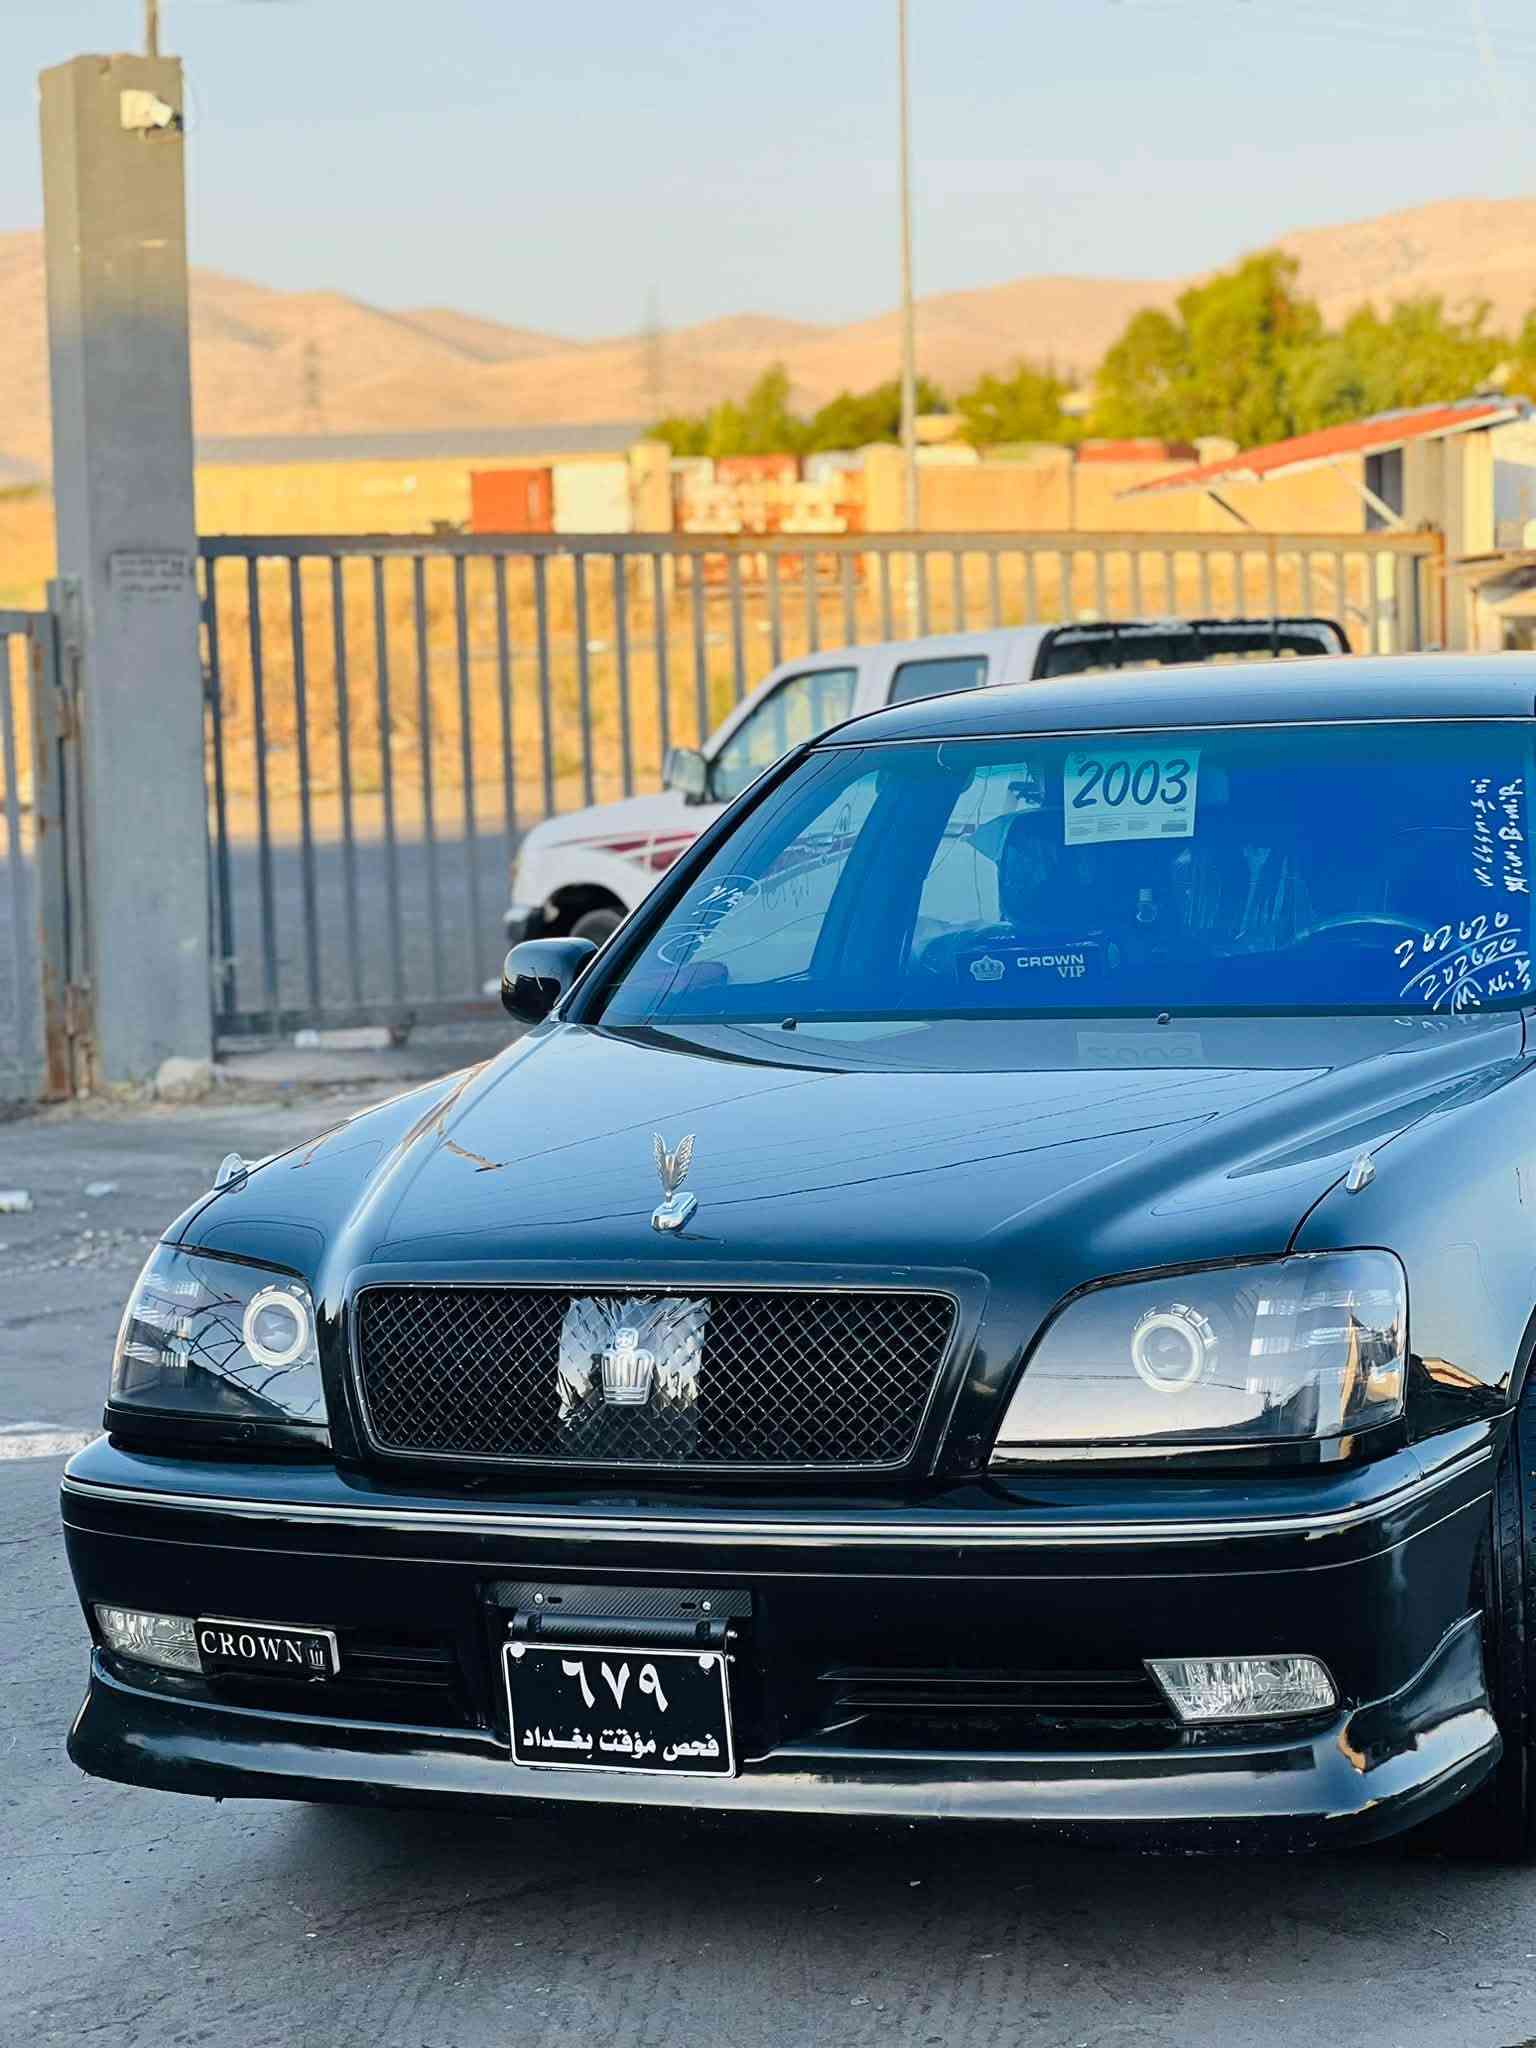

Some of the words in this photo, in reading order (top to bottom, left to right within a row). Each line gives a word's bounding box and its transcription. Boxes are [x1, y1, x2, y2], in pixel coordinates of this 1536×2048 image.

[1072, 758, 1191, 809] 2003
[1016, 953, 1085, 968] CROWN
[1057, 965, 1087, 979] VIP
[200, 1629, 304, 1665] CROWN
[561, 1658, 670, 1714] ٦٧٩
[522, 1725, 594, 1760] بغداد
[598, 1728, 658, 1759] مؤقت
[661, 1731, 721, 1763] فحص
